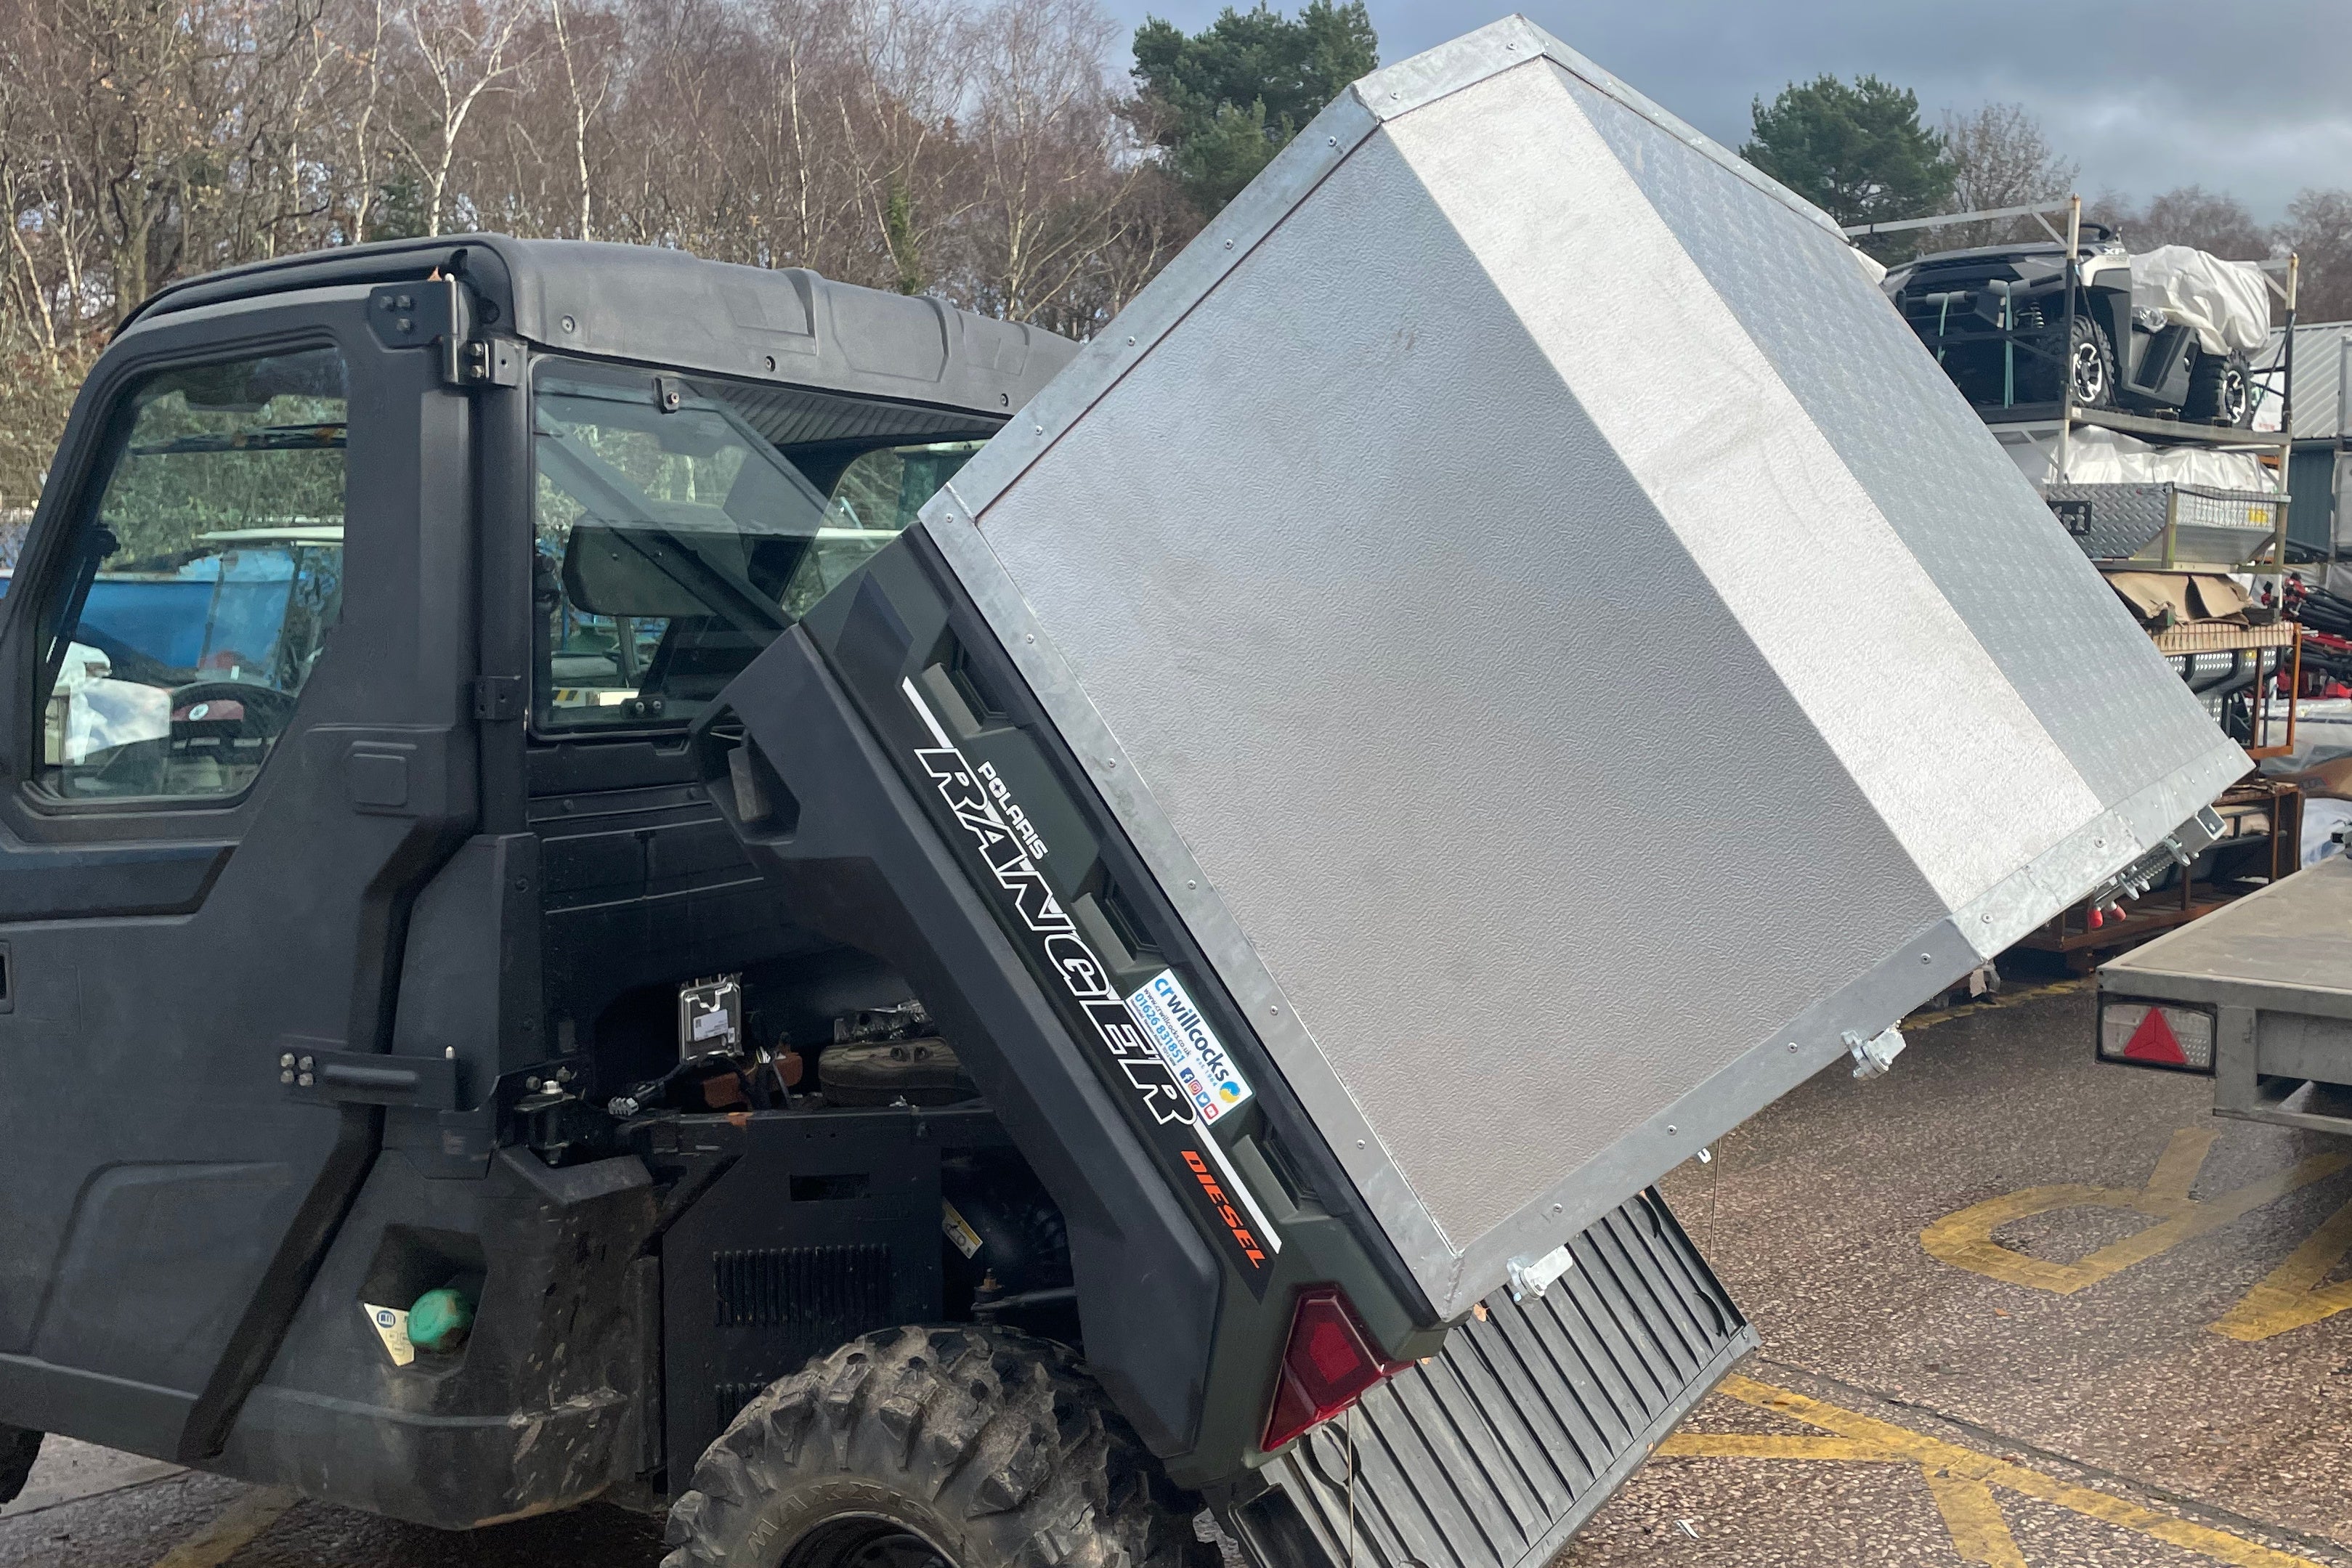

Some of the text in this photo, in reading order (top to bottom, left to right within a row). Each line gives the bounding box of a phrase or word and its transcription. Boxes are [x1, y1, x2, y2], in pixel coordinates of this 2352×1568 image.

[977, 760, 1049, 860] POLARIS
[915, 747, 1198, 1125] RANGER
[1135, 993, 1185, 1063] 01626 831851
[1144, 988, 1192, 1057] www.crwillcocks.co.uk
[1154, 978, 1229, 1081] crwillcocks
[1182, 1150, 1265, 1269] DIESEL
